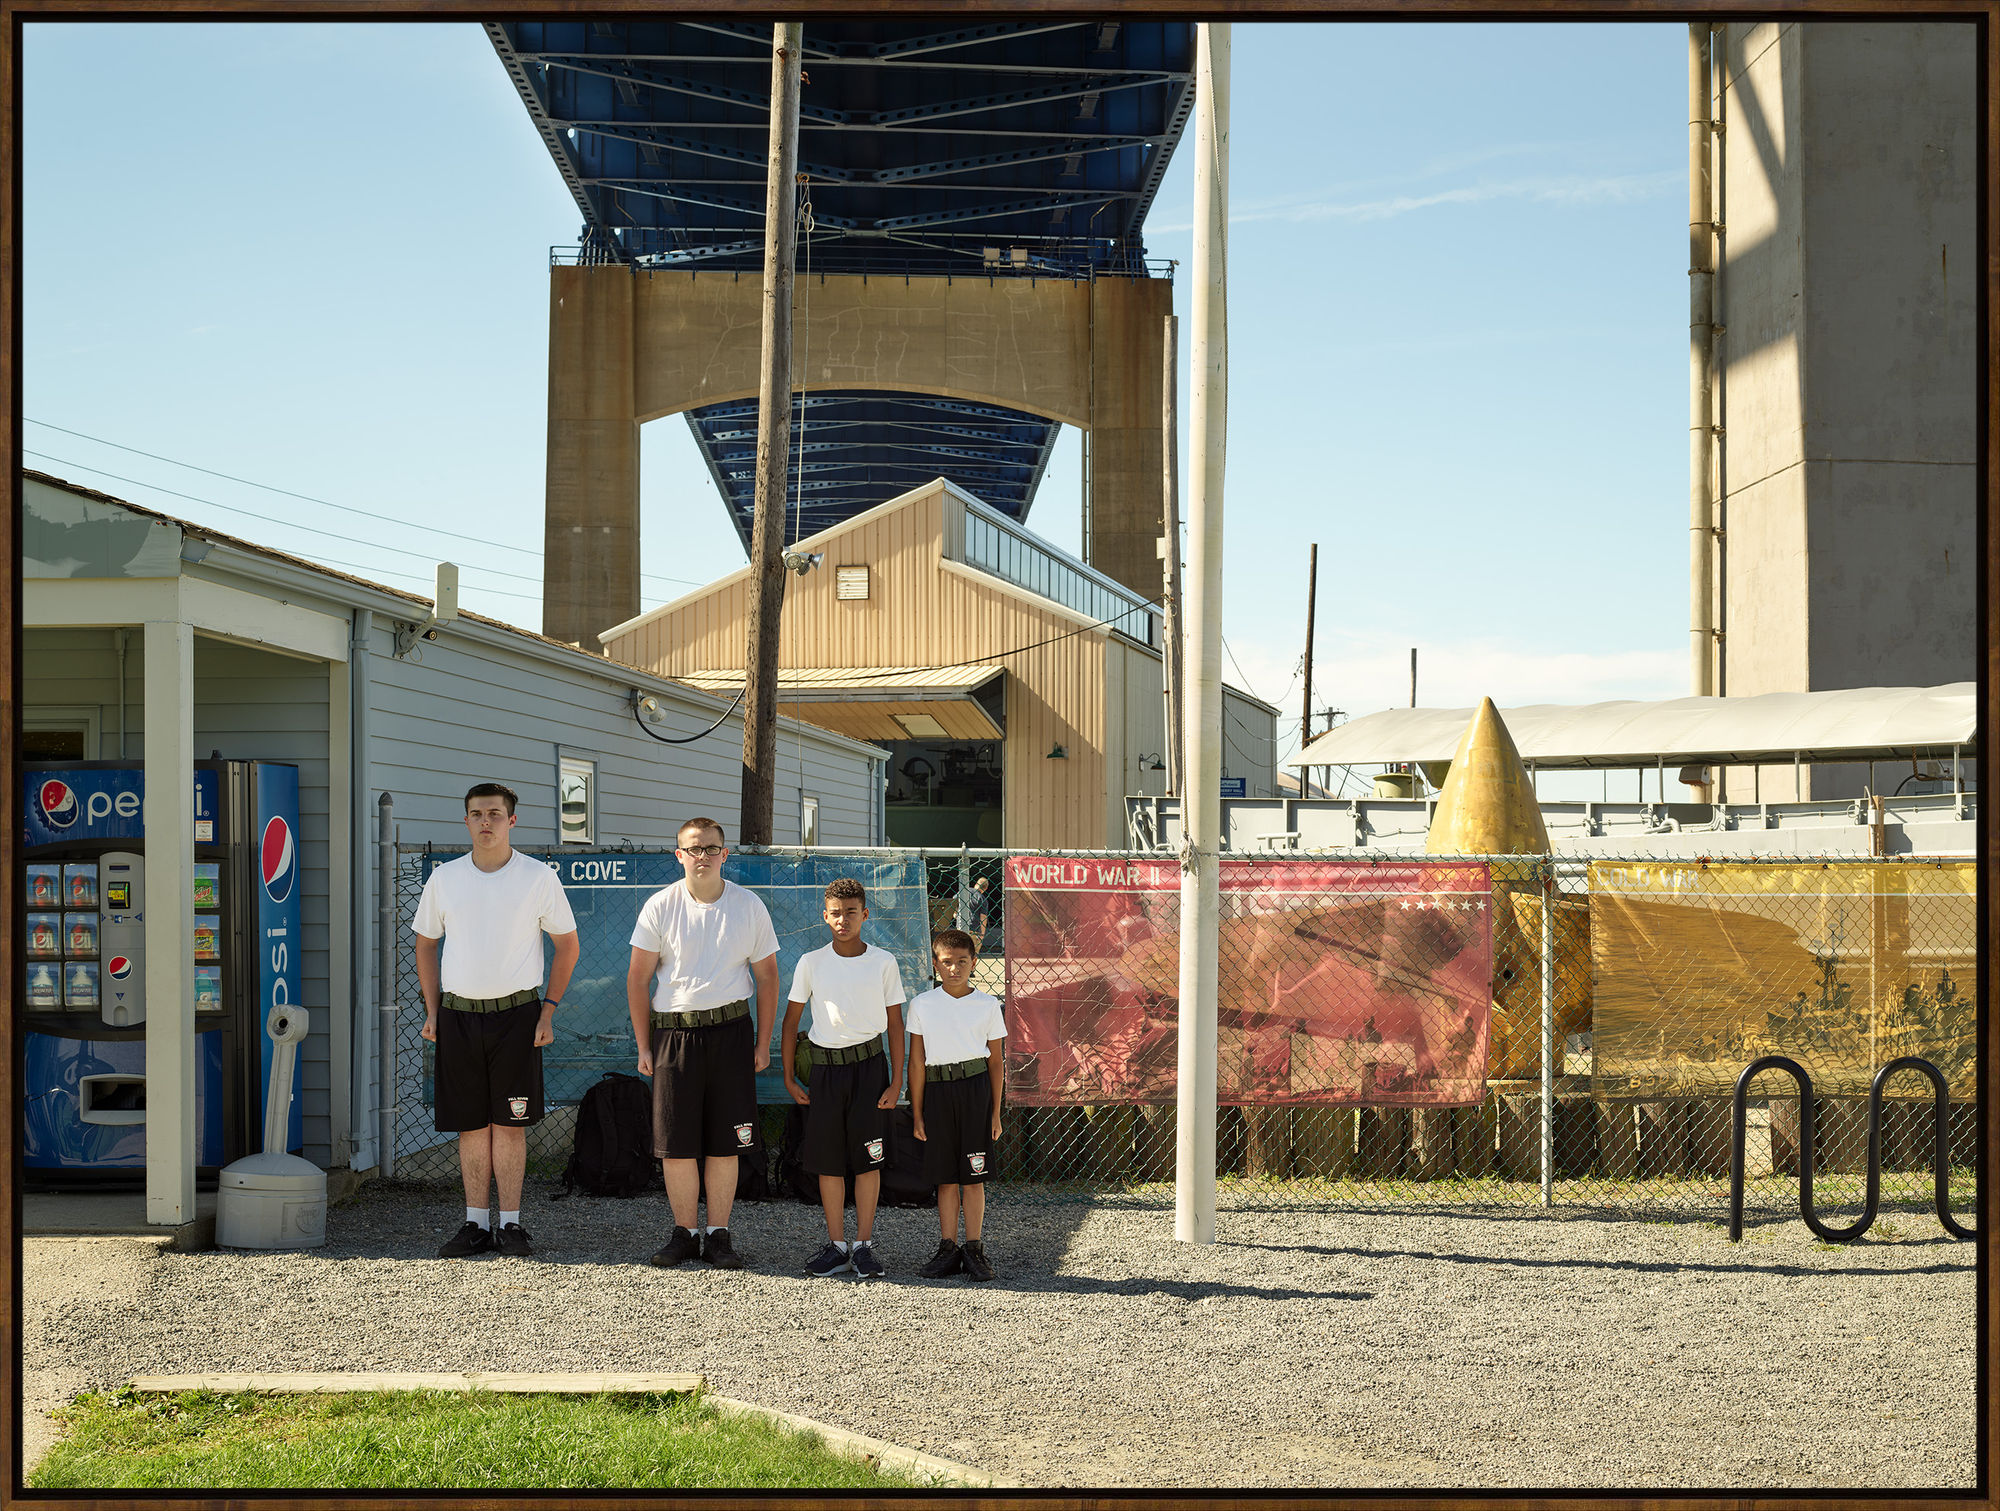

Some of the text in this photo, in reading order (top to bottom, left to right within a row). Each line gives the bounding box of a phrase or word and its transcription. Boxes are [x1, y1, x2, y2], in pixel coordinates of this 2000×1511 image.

[87, 783, 202, 826] pei
[571, 861, 627, 881] COVE
[1014, 863, 1160, 886] WORLD WAR II
[1596, 868, 1700, 889] COLD WAR
